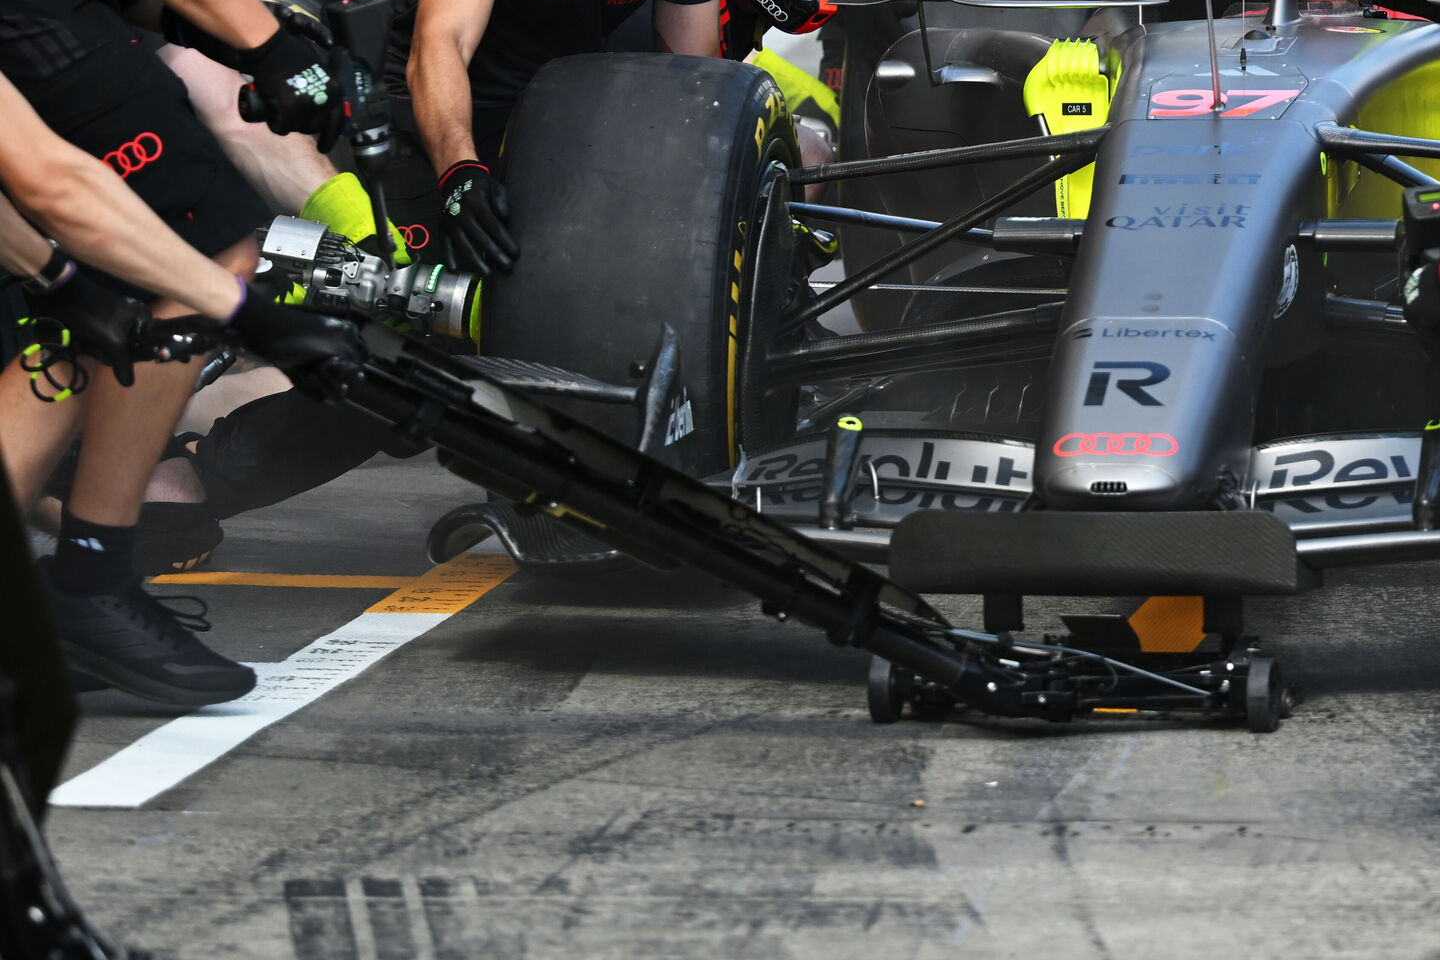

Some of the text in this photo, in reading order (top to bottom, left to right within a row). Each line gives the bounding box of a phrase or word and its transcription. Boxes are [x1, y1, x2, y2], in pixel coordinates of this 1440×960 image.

[1067, 104, 1087, 114] CAR 5
[1149, 89, 1300, 117] 97
[1153, 203, 1252, 216] visit
[1104, 215, 1247, 231] QATAR
[1102, 327, 1217, 341] Libertex
[1083, 361, 1171, 406] R
